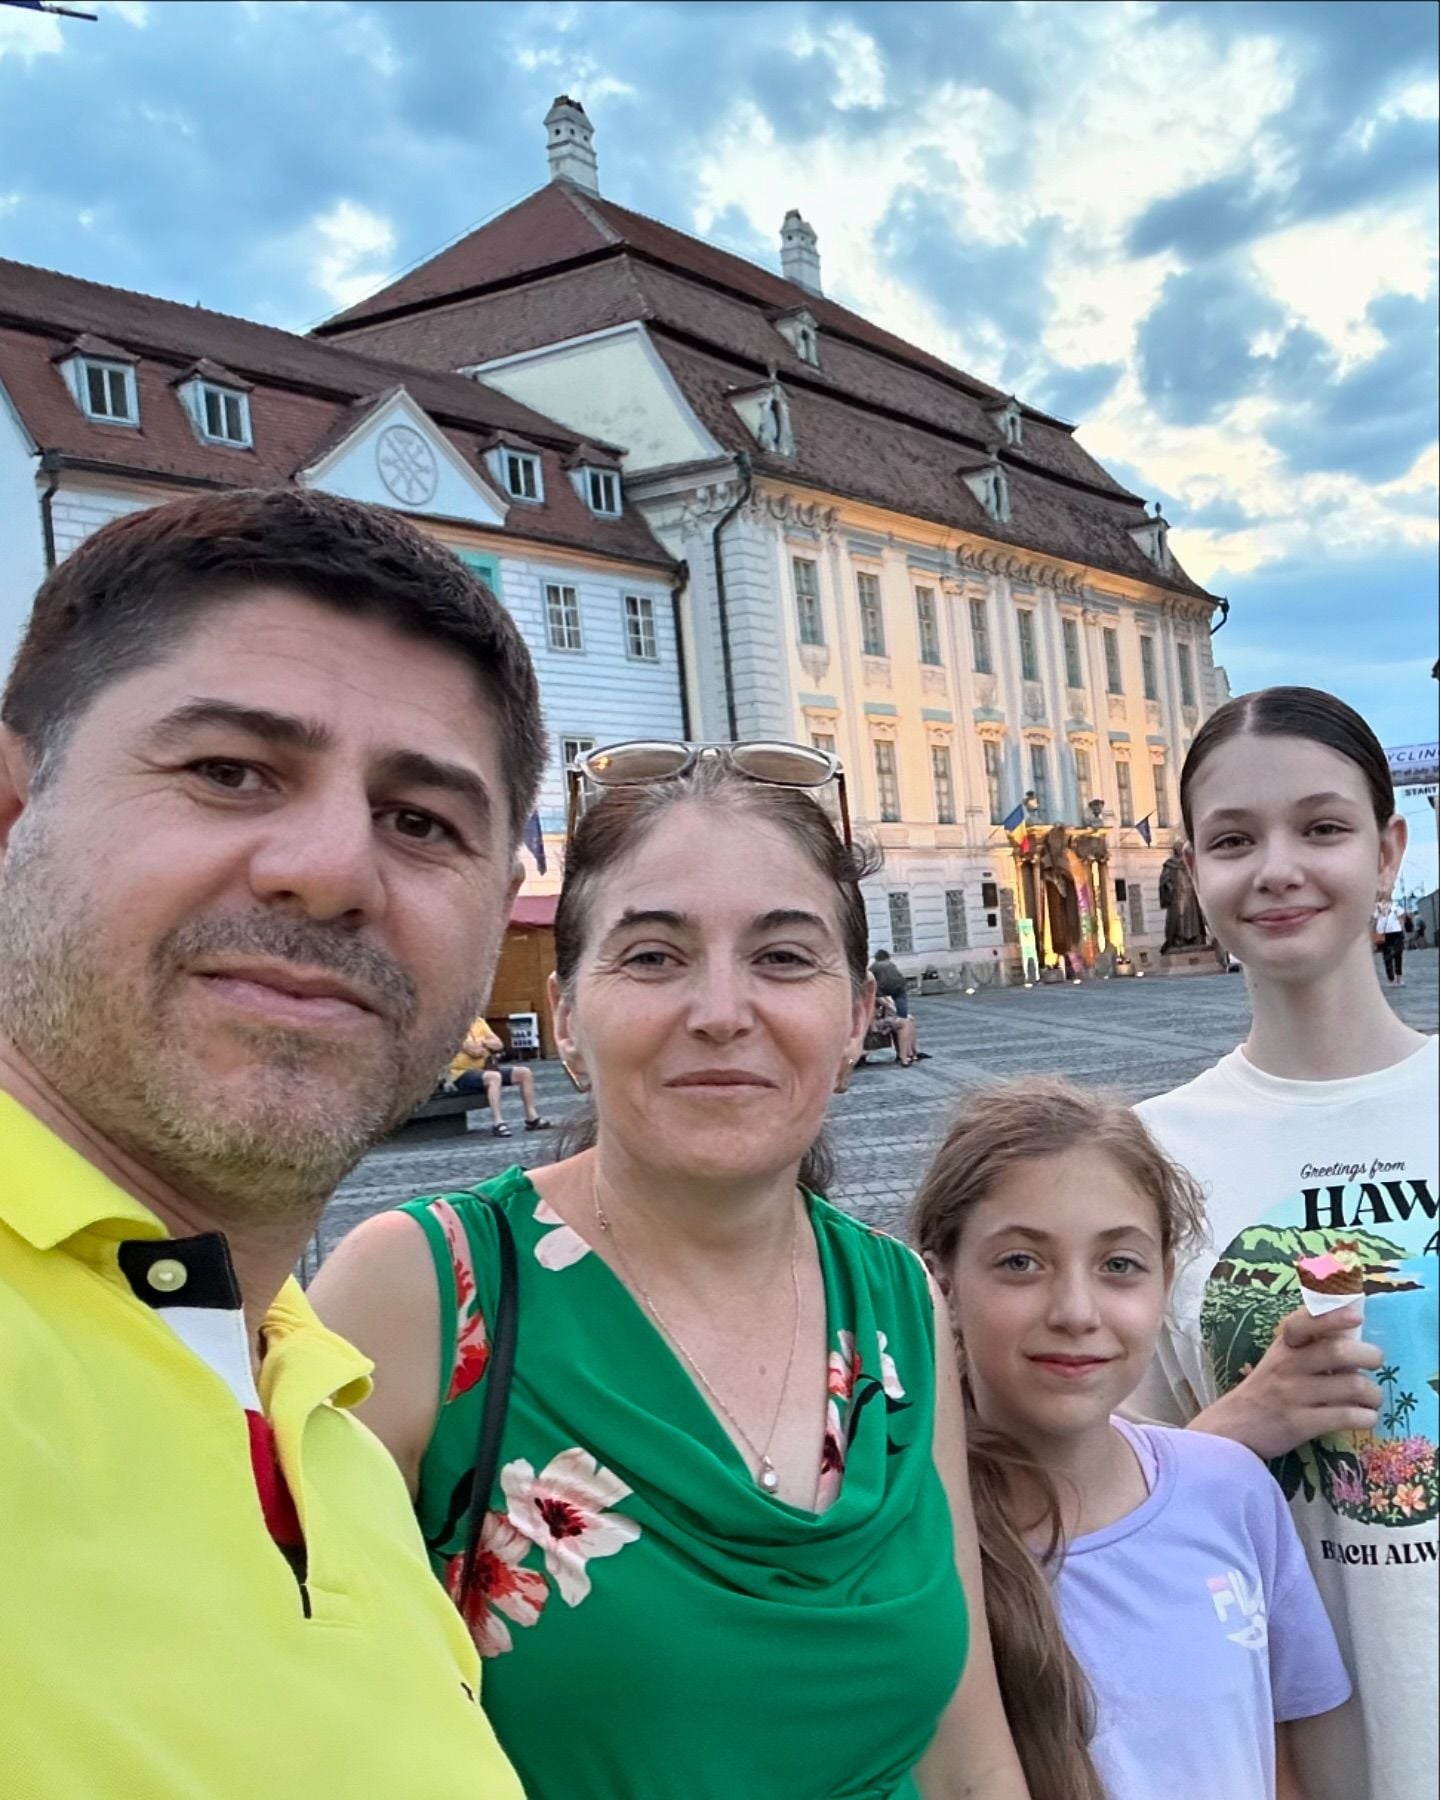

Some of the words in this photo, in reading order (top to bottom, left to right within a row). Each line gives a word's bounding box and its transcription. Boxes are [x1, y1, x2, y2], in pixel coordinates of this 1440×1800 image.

[1404, 786, 1437, 797] START
[1300, 1162, 1367, 1182] Greetings
[1368, 1158, 1406, 1180] from
